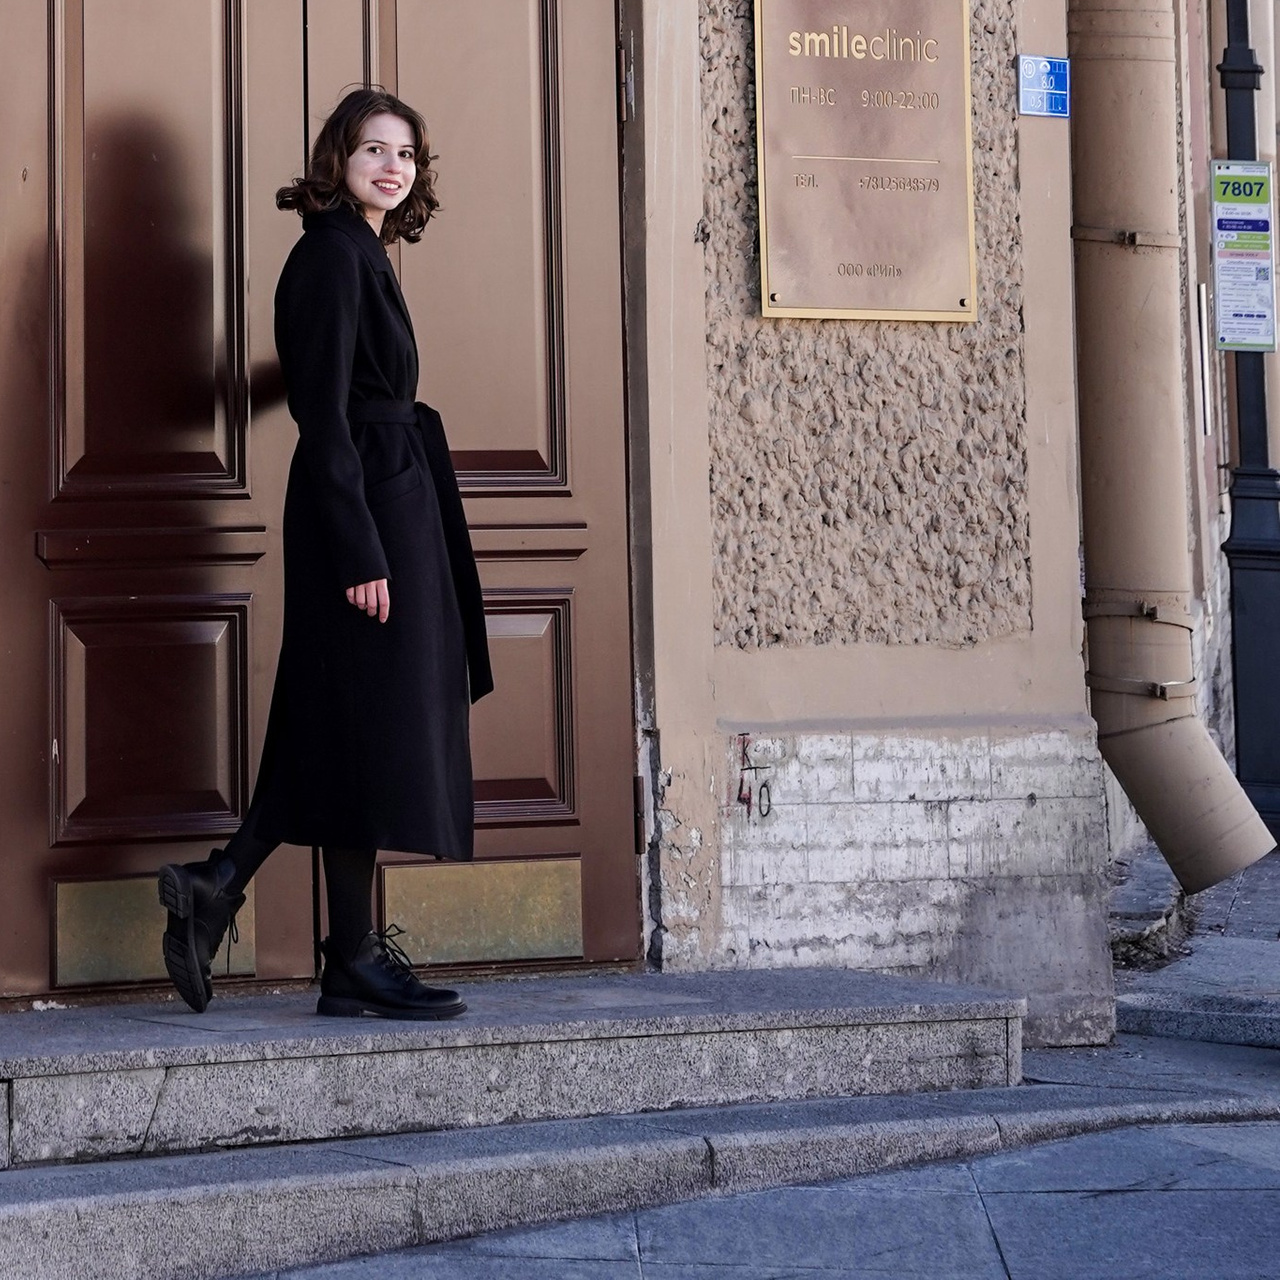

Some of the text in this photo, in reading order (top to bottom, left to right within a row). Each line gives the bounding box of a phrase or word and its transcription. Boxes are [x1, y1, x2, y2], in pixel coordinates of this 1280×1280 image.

[788, 25, 939, 63] smileclinic
[790, 87, 940, 110] ПН-ВС 9:00-22:00
[793, 174, 819, 188] ТЕЛ.
[1220, 181, 1265, 197] 7807
[837, 263, 864, 277] ООО
